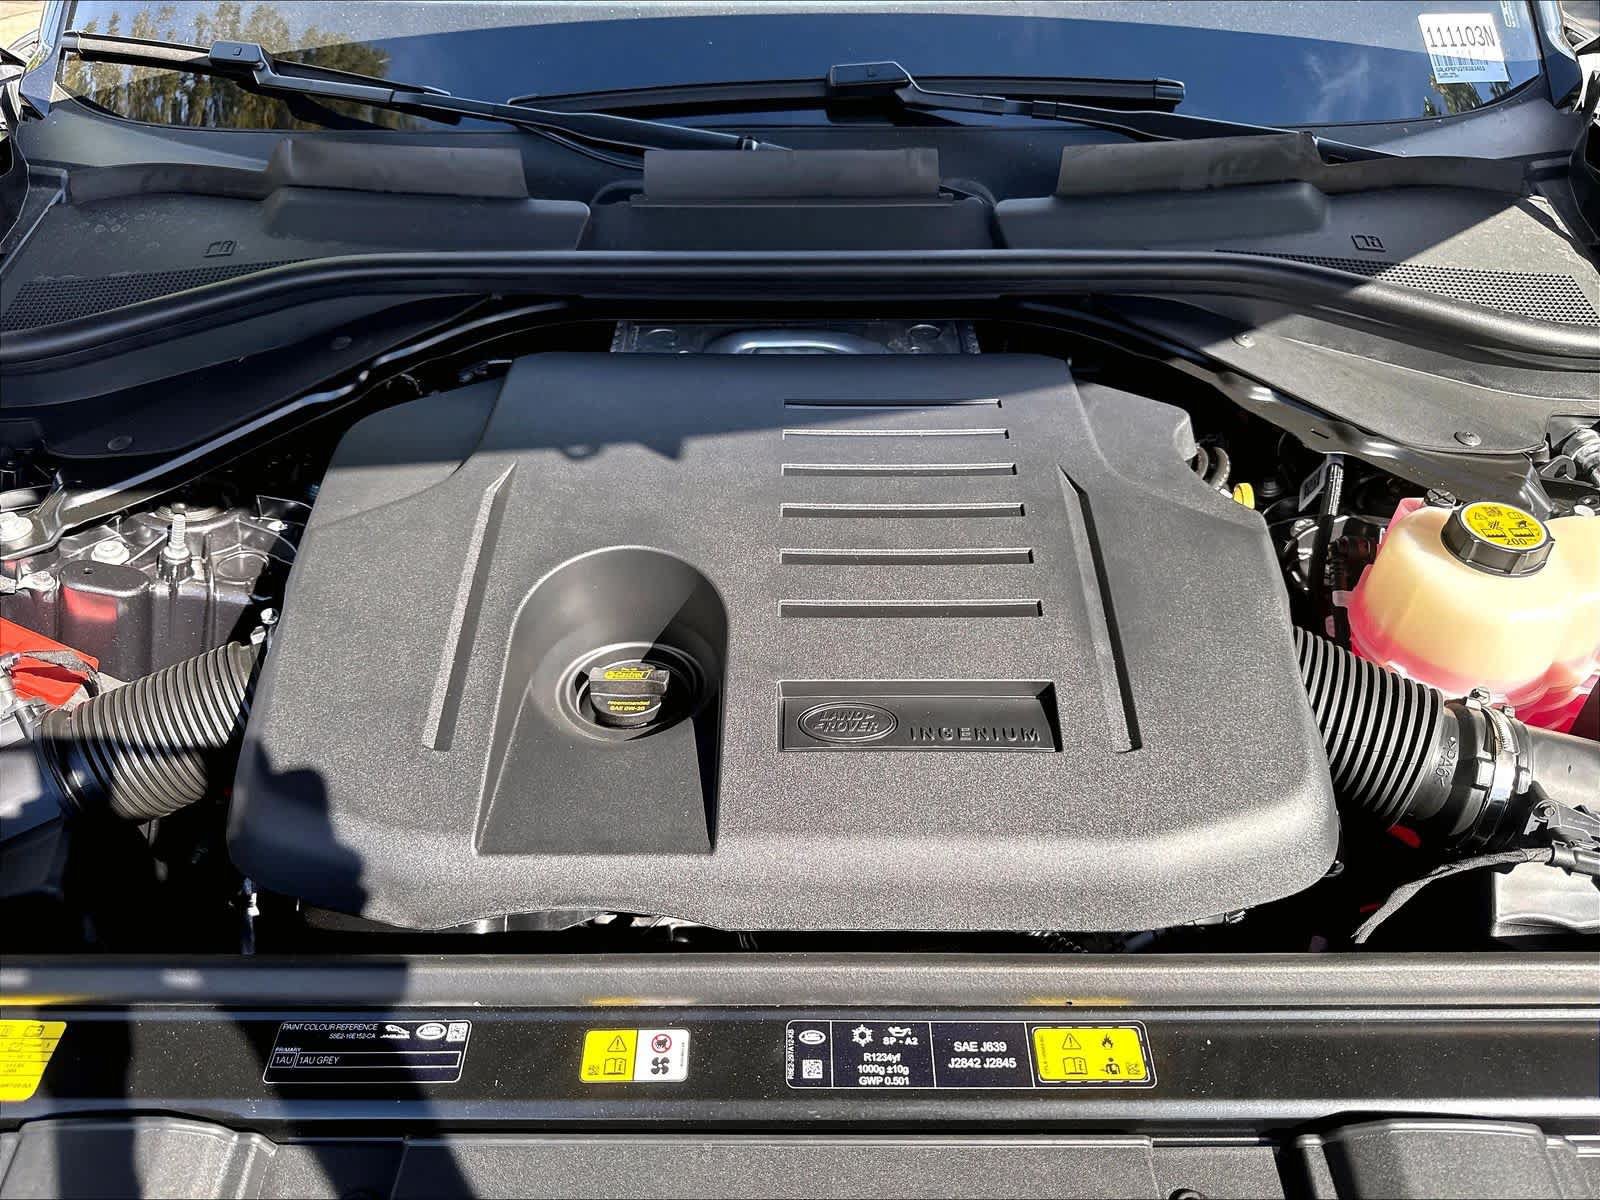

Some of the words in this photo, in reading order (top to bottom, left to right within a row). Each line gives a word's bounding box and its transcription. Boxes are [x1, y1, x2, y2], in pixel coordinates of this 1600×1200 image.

[1426, 25, 1496, 48] 111103N
[1506, 538, 1528, 546] 200
[820, 711, 865, 721] LAND
[822, 721, 880, 733] ROVER
[909, 726, 1041, 742] INGENIUM
[282, 1023, 304, 1031] PAINT
[304, 1023, 335, 1031] COLOUR
[336, 1023, 379, 1031] REFERENCE
[882, 1037, 897, 1045] SP
[904, 1037, 919, 1045] A2
[953, 1041, 978, 1052] SAE
[980, 1041, 1008, 1052] J639
[276, 1056, 294, 1064] 1AU
[299, 1056, 316, 1064] 1AU
[316, 1055, 340, 1065] GREY
[863, 1052, 902, 1063] R1234yf
[948, 1058, 982, 1069] J2842
[983, 1058, 1017, 1069] J2845
[857, 1065, 886, 1075] 1000g
[886, 1065, 910, 1075] ±10g
[858, 1076, 883, 1085] GWP
[884, 1076, 910, 1085] 0.501
